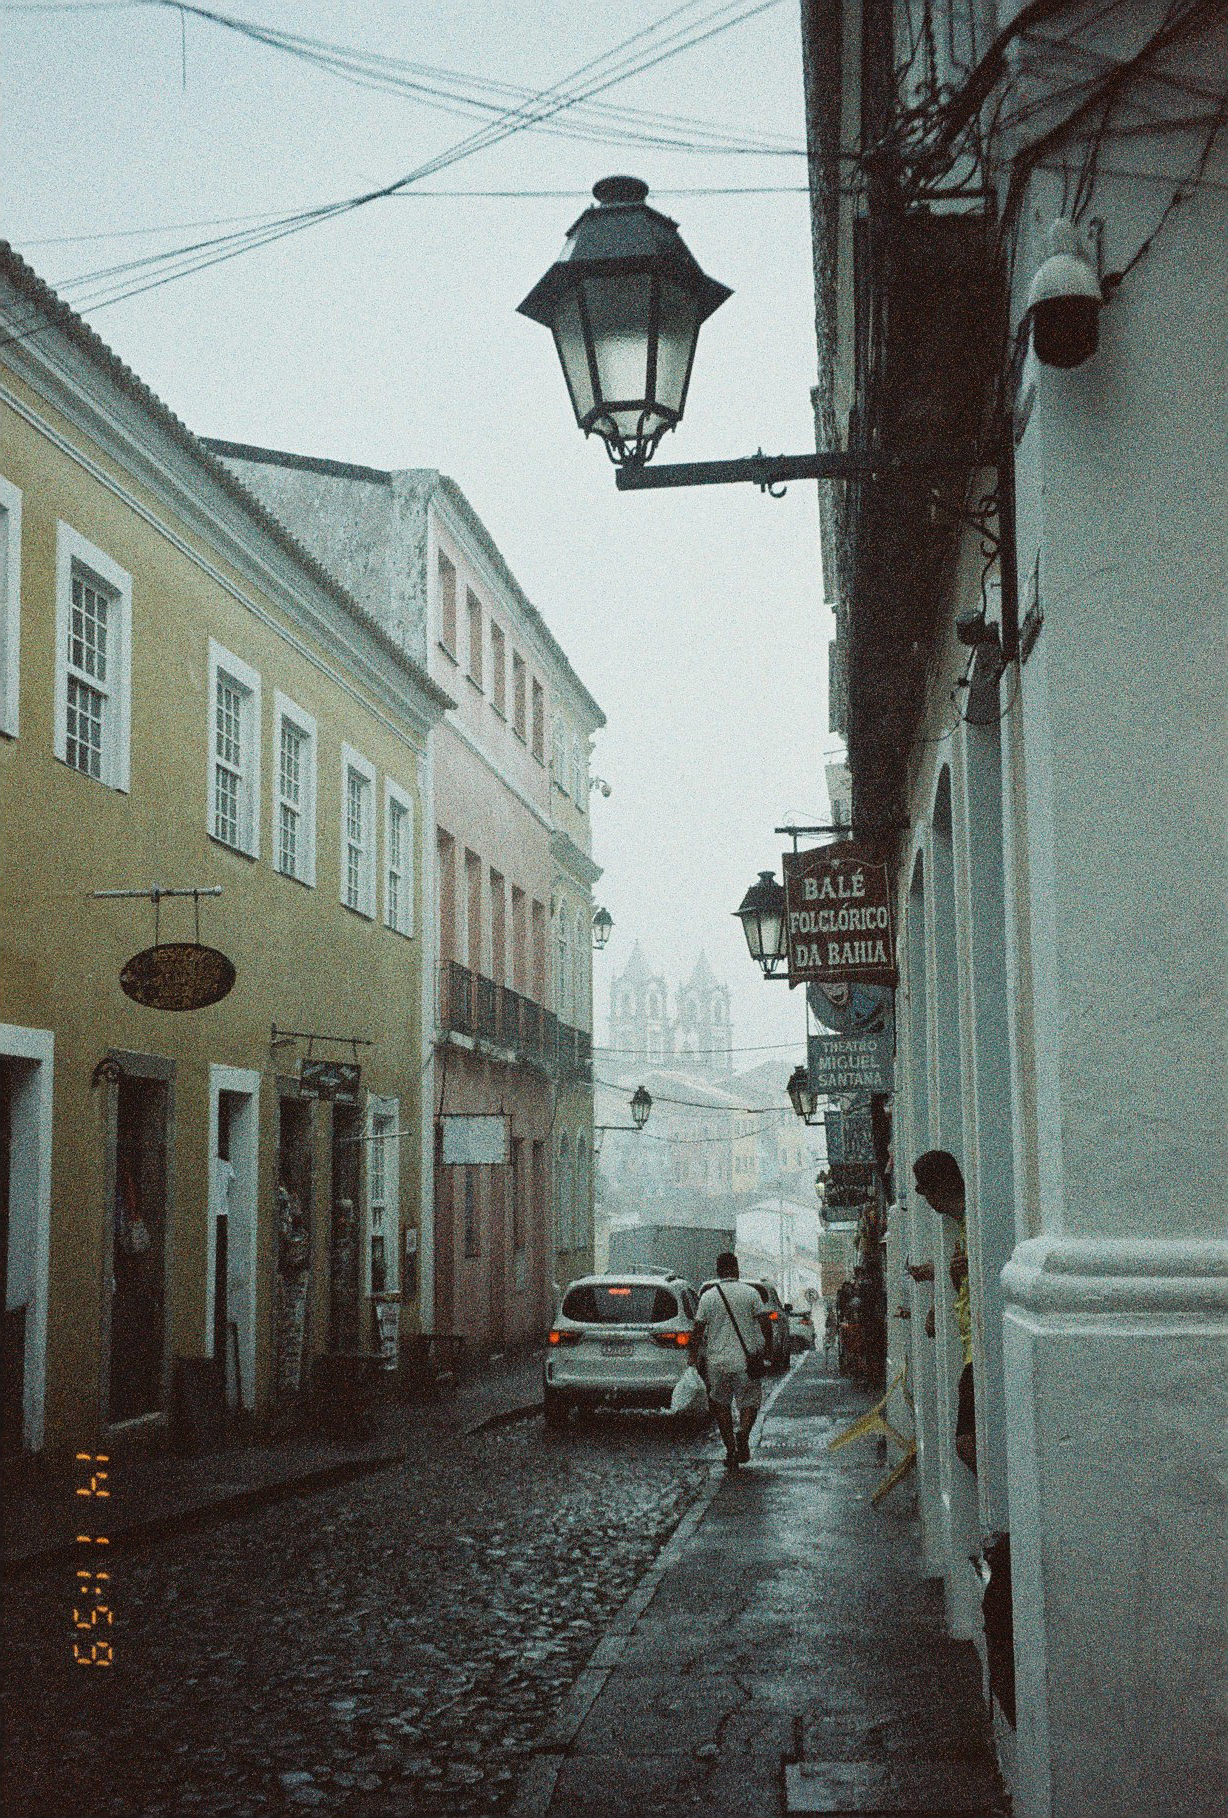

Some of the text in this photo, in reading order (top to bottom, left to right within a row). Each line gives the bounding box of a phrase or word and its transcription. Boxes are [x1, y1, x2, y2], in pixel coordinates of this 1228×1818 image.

[804, 867, 866, 900] BALÉ
[789, 902, 887, 933] FOLCLÓRICO
[795, 939, 887, 967] DA BAHIA
[818, 1053, 880, 1070] MIGUEL
[818, 1071, 882, 1087] SANTANA
